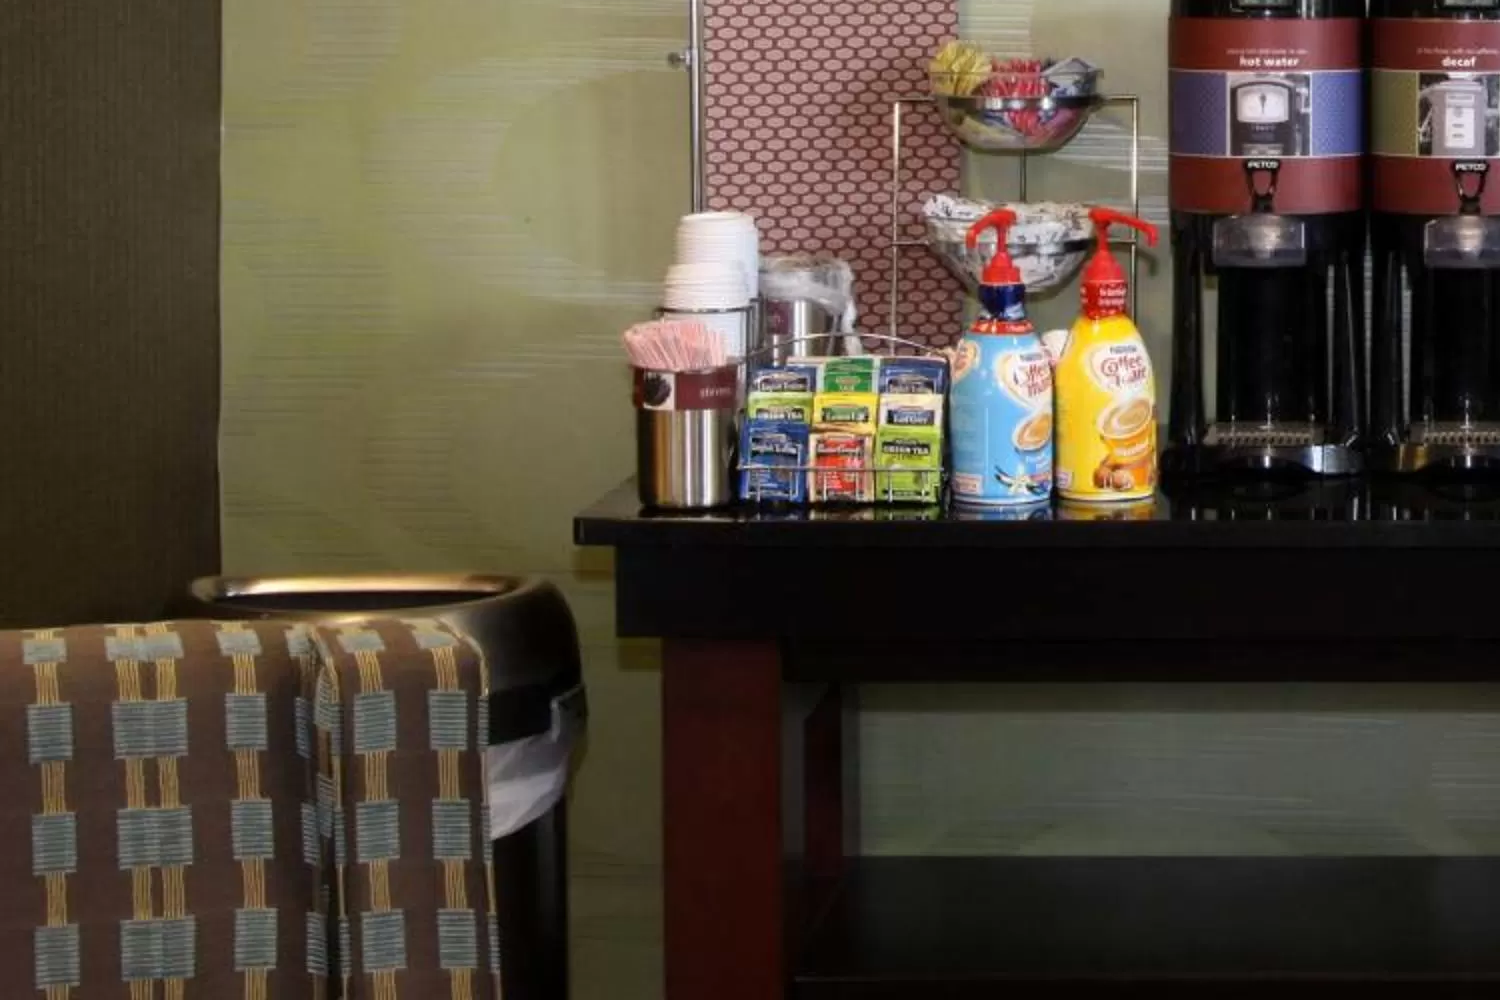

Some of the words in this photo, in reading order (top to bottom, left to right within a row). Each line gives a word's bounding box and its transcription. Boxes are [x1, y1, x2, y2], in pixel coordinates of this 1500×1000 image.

[1239, 56, 1261, 67] hot
[1263, 56, 1300, 67] water
[1441, 56, 1477, 67] decaf
